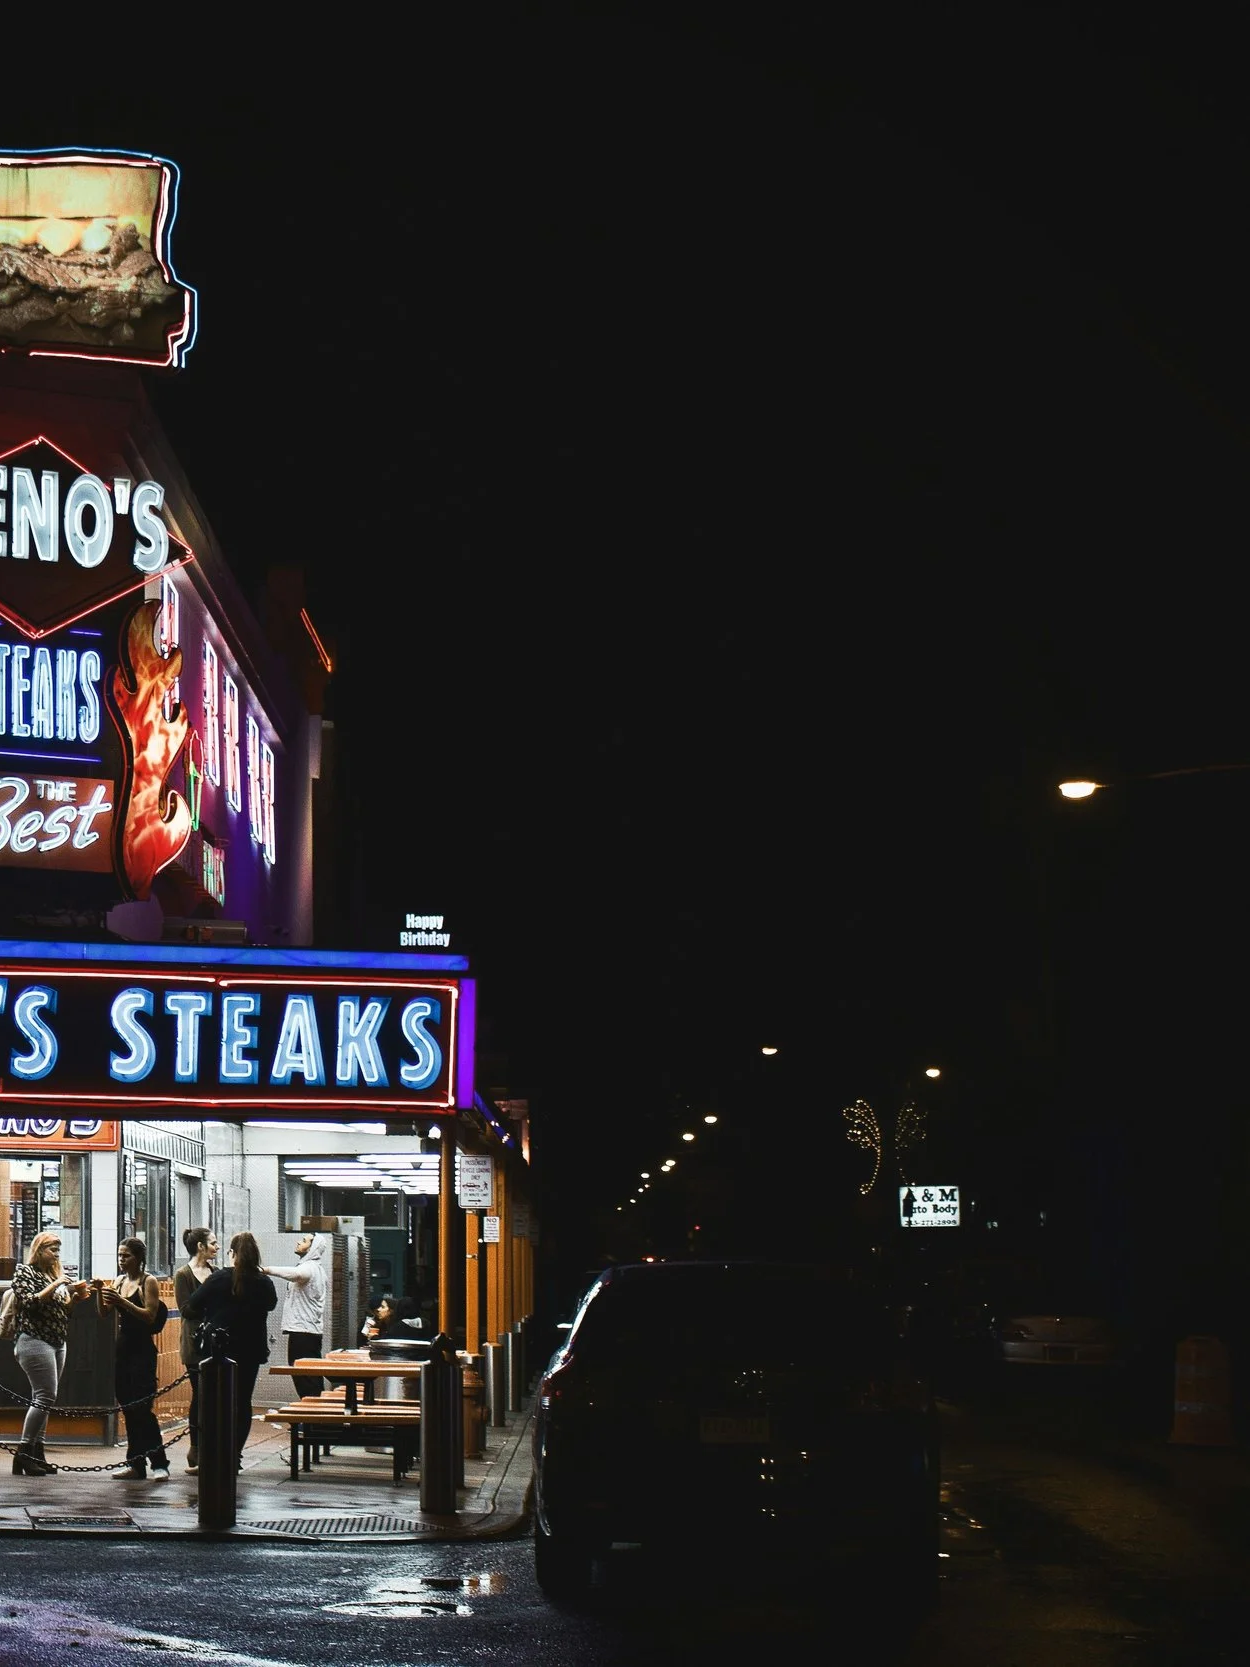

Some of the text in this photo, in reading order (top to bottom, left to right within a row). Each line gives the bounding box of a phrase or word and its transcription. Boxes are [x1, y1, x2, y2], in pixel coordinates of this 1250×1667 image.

[33, 779, 77, 803] THE
[405, 913, 444, 930] Happy
[399, 931, 451, 947] Birthday
[108, 986, 443, 1089] STEAKS
[922, 1188, 934, 1202] &
[939, 1188, 957, 1202] M
[932, 1204, 958, 1216] Body
